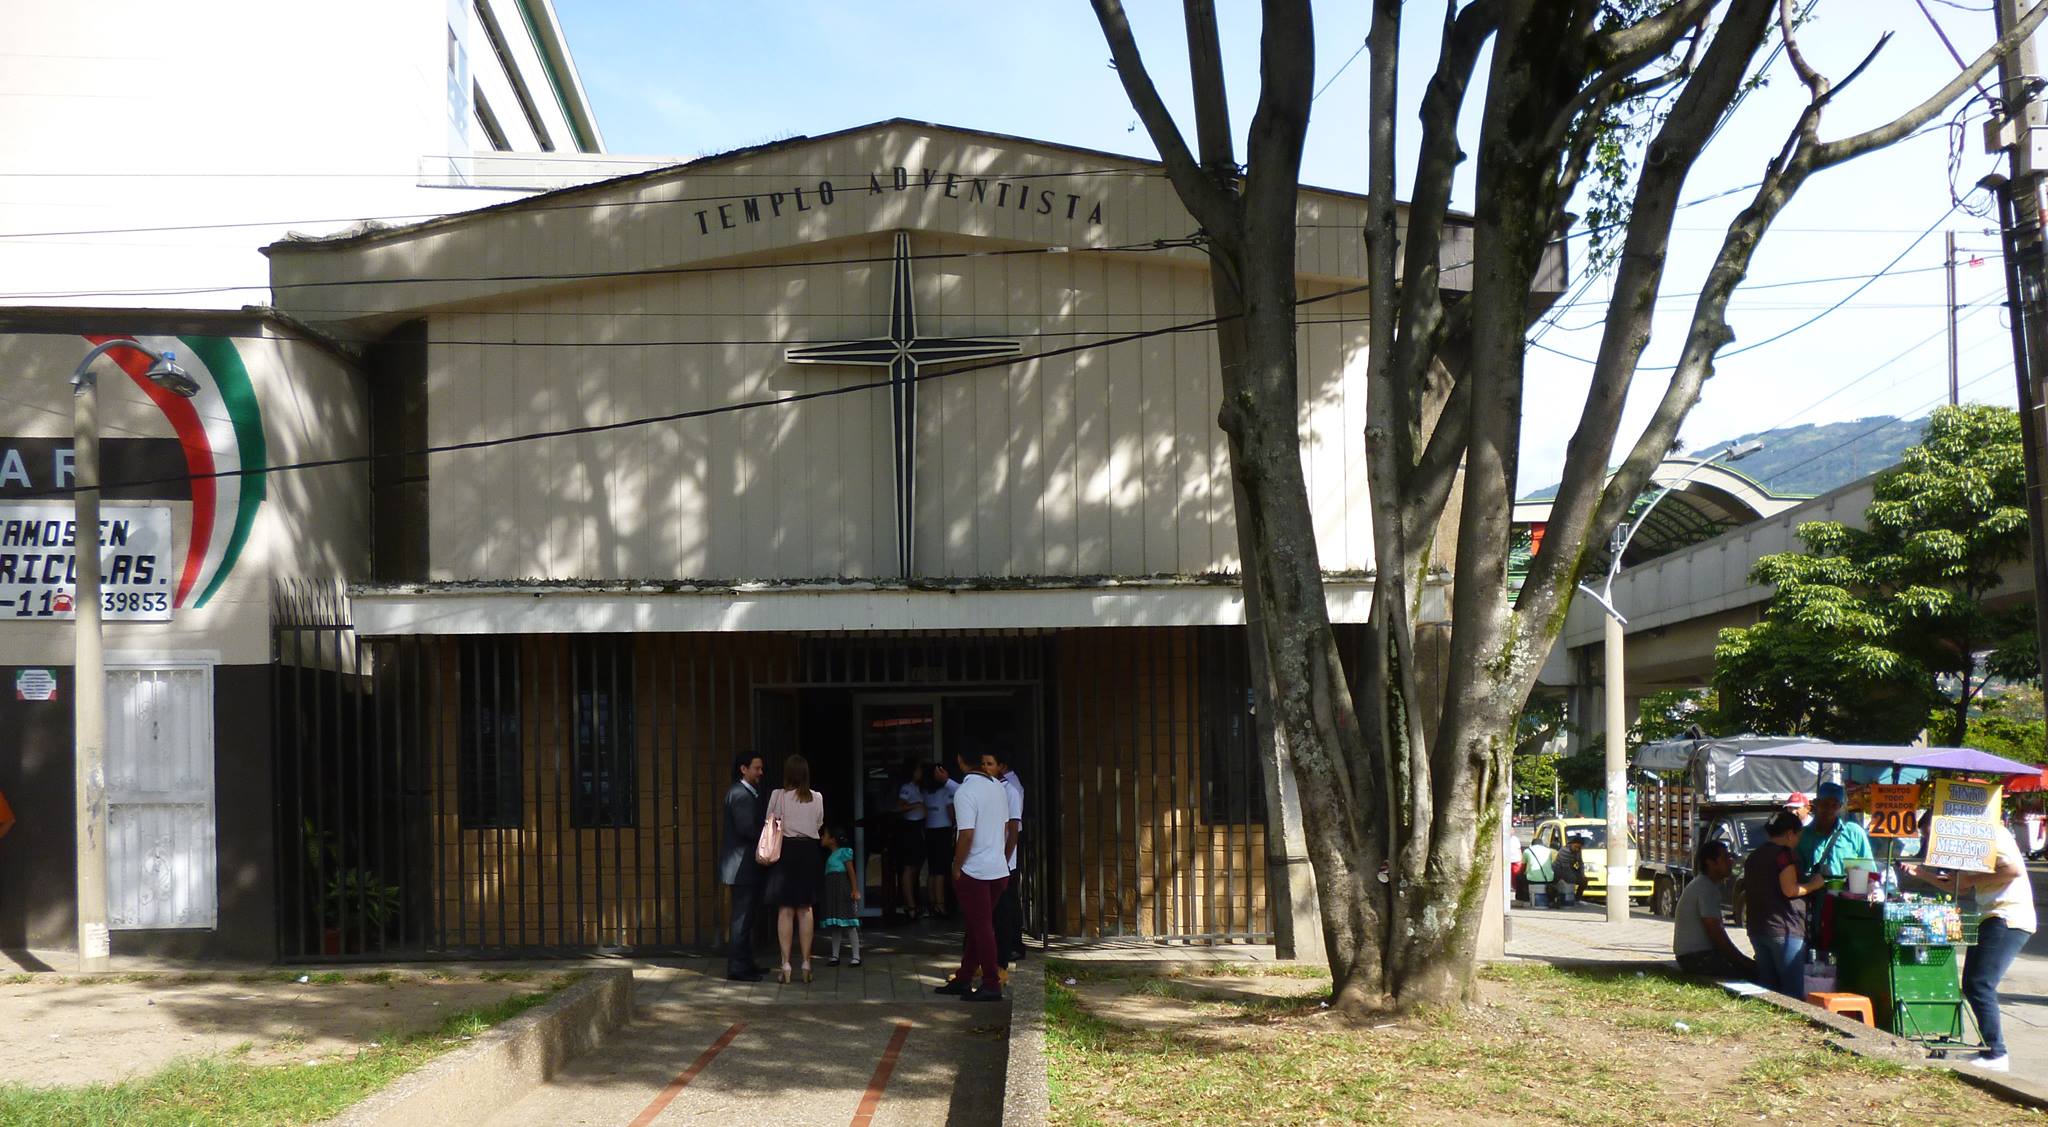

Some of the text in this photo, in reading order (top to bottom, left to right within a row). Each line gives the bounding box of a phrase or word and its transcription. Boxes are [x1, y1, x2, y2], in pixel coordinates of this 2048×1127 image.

[694, 166, 1103, 235] TEMPLO ADVENTISTA
[0, 520, 75, 547] AMOS
[101, 592, 167, 616] 39853
[1949, 784, 1988, 803] TINTO
[1871, 811, 1917, 835] 200
[1935, 819, 1996, 839] GASEOSA
[1935, 837, 1990, 857] MEKATO
